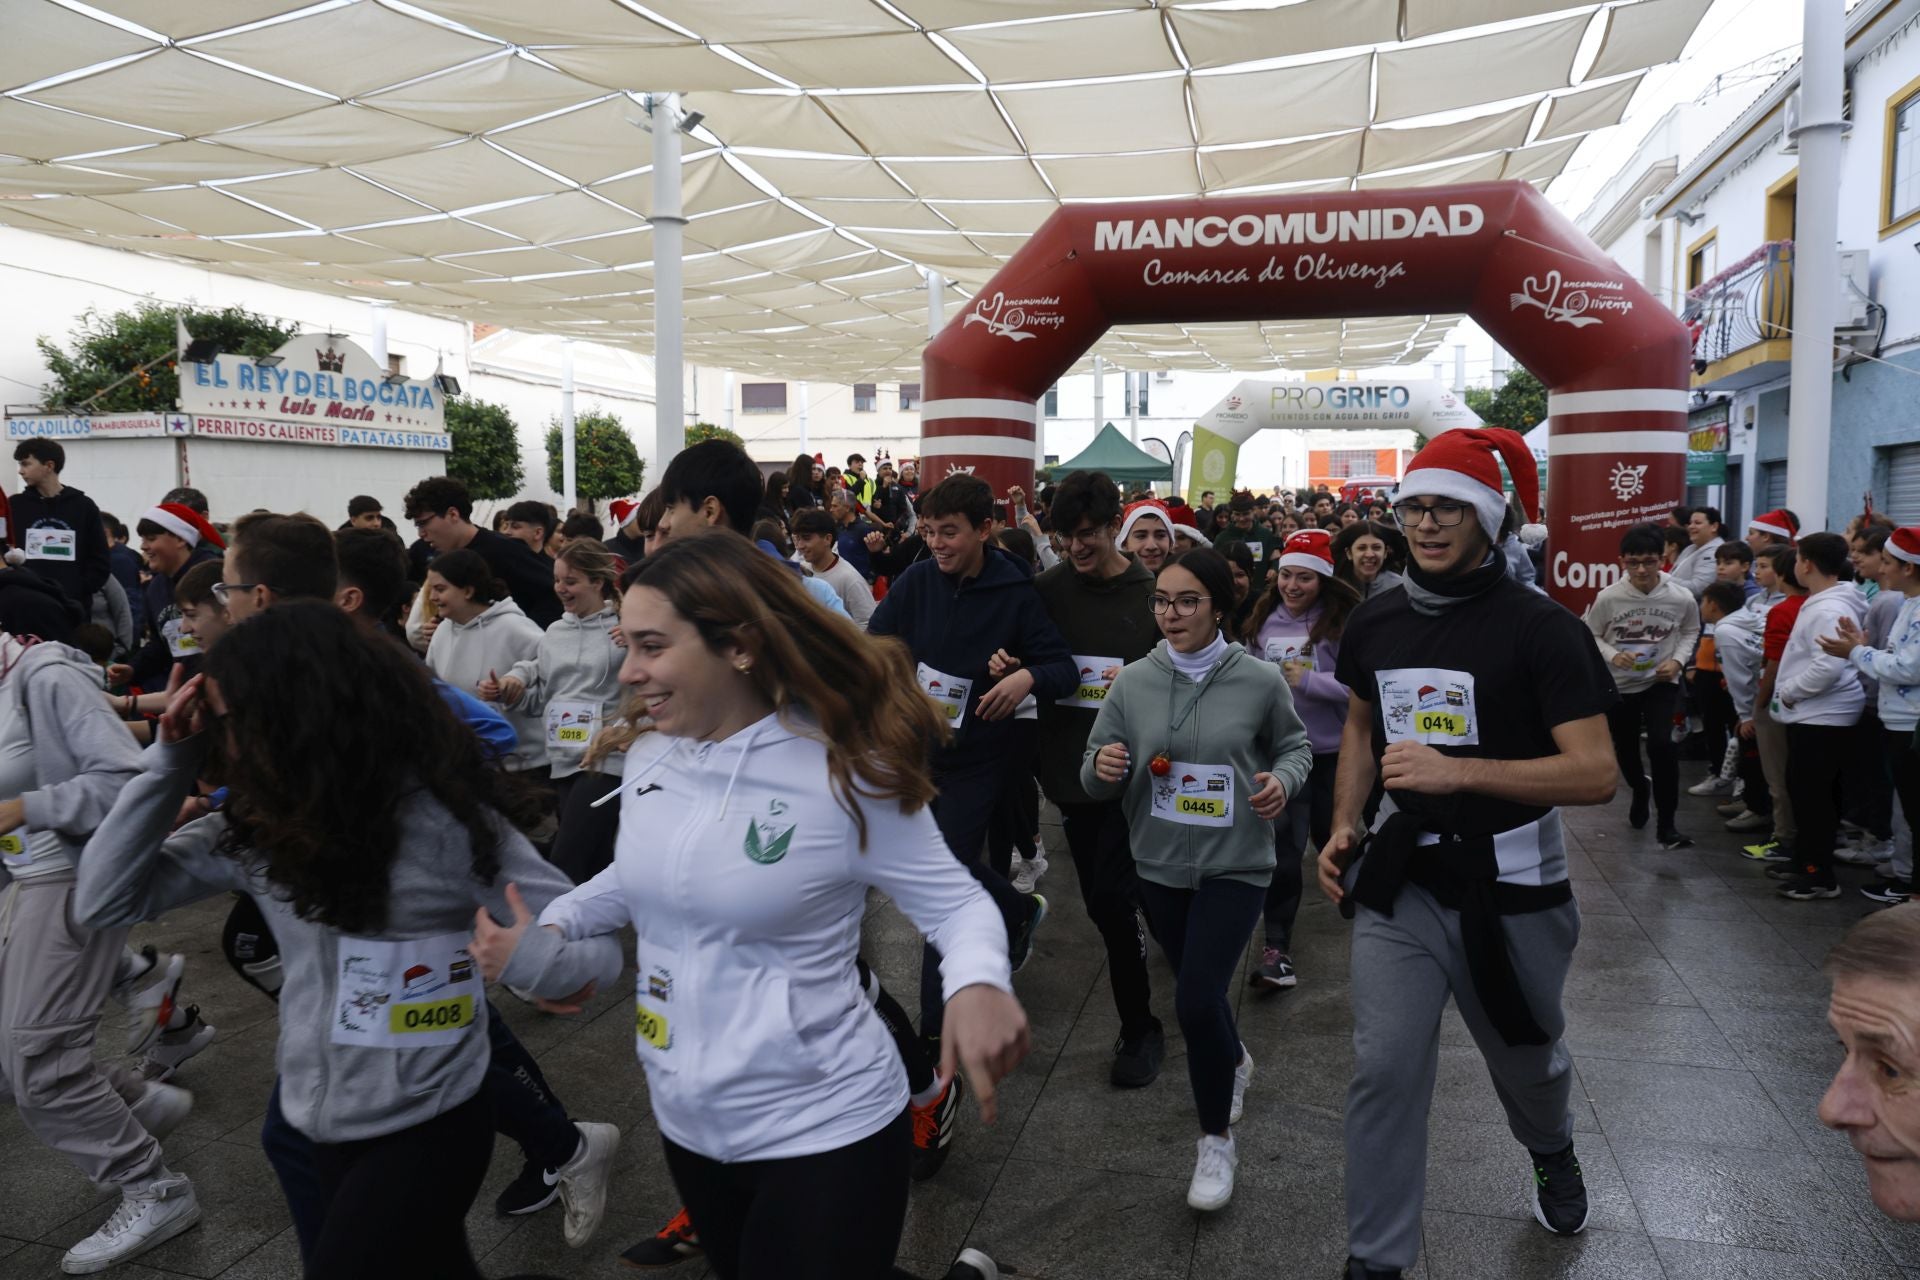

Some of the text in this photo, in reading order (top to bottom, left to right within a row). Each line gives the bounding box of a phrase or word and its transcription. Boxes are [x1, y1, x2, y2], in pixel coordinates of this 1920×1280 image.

[1094, 203, 1484, 251] MANCOMUNIDAD
[1143, 253, 1406, 289] Comarca de Olivenza
[195, 362, 229, 388] EL
[238, 363, 289, 394] REY
[294, 371, 339, 399] DEL
[279, 396, 375, 421] Luis Marín
[1215, 412, 1248, 420] PROMEDIO
[1271, 411, 1410, 421] EVENTOS CON AGUA DEL GRIFO
[10, 418, 91, 436] BOCADILLOS
[91, 419, 161, 430] HAMBURGUESAS
[197, 418, 335, 441] PERRITOS CALIENTES
[342, 429, 448, 448] PATATAS FRITAS
[1570, 510, 1614, 523] Deportistas
[1616, 508, 1630, 518] por
[1553, 550, 1621, 589] Com
[1081, 688, 1107, 699] 0452
[1422, 716, 1455, 732] 0414
[561, 730, 582, 740] 2018
[1183, 799, 1215, 814] 0445
[404, 1003, 461, 1029] 0408
